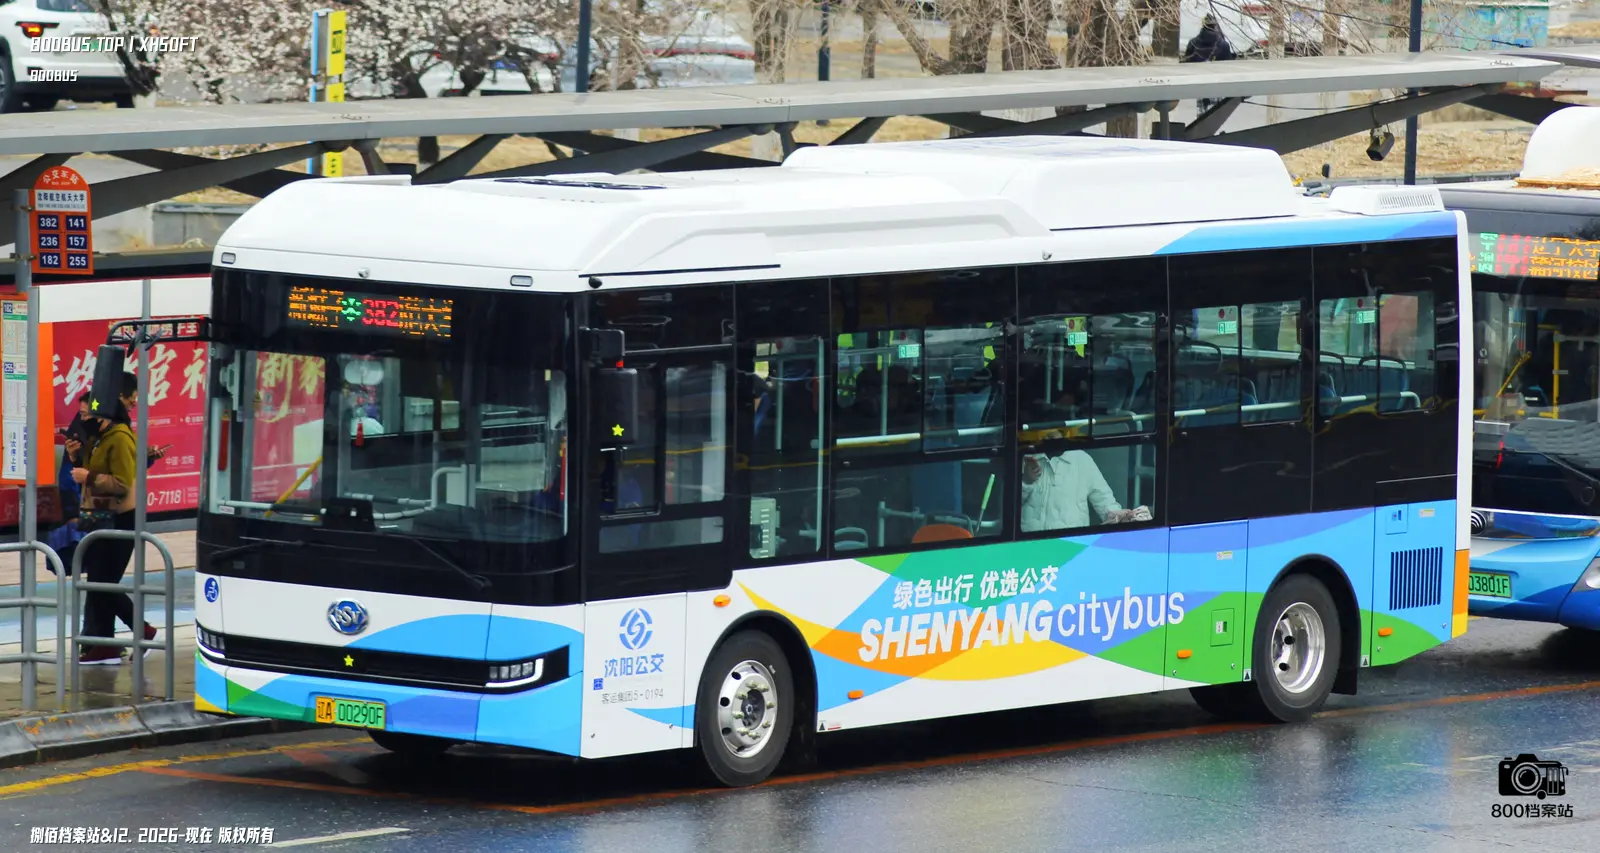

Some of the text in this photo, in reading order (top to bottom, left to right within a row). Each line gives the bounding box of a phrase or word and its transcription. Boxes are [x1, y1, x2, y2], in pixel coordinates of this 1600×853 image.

[40, 217, 84, 228] 382 141
[40, 236, 85, 247] 236 157
[42, 255, 86, 266] 182 255
[361, 298, 400, 328] 382
[892, 565, 1059, 610] 绿色出行 优选公交
[857, 586, 1185, 663] SHENYANG citybus
[604, 653, 665, 678] 沈阳公交
